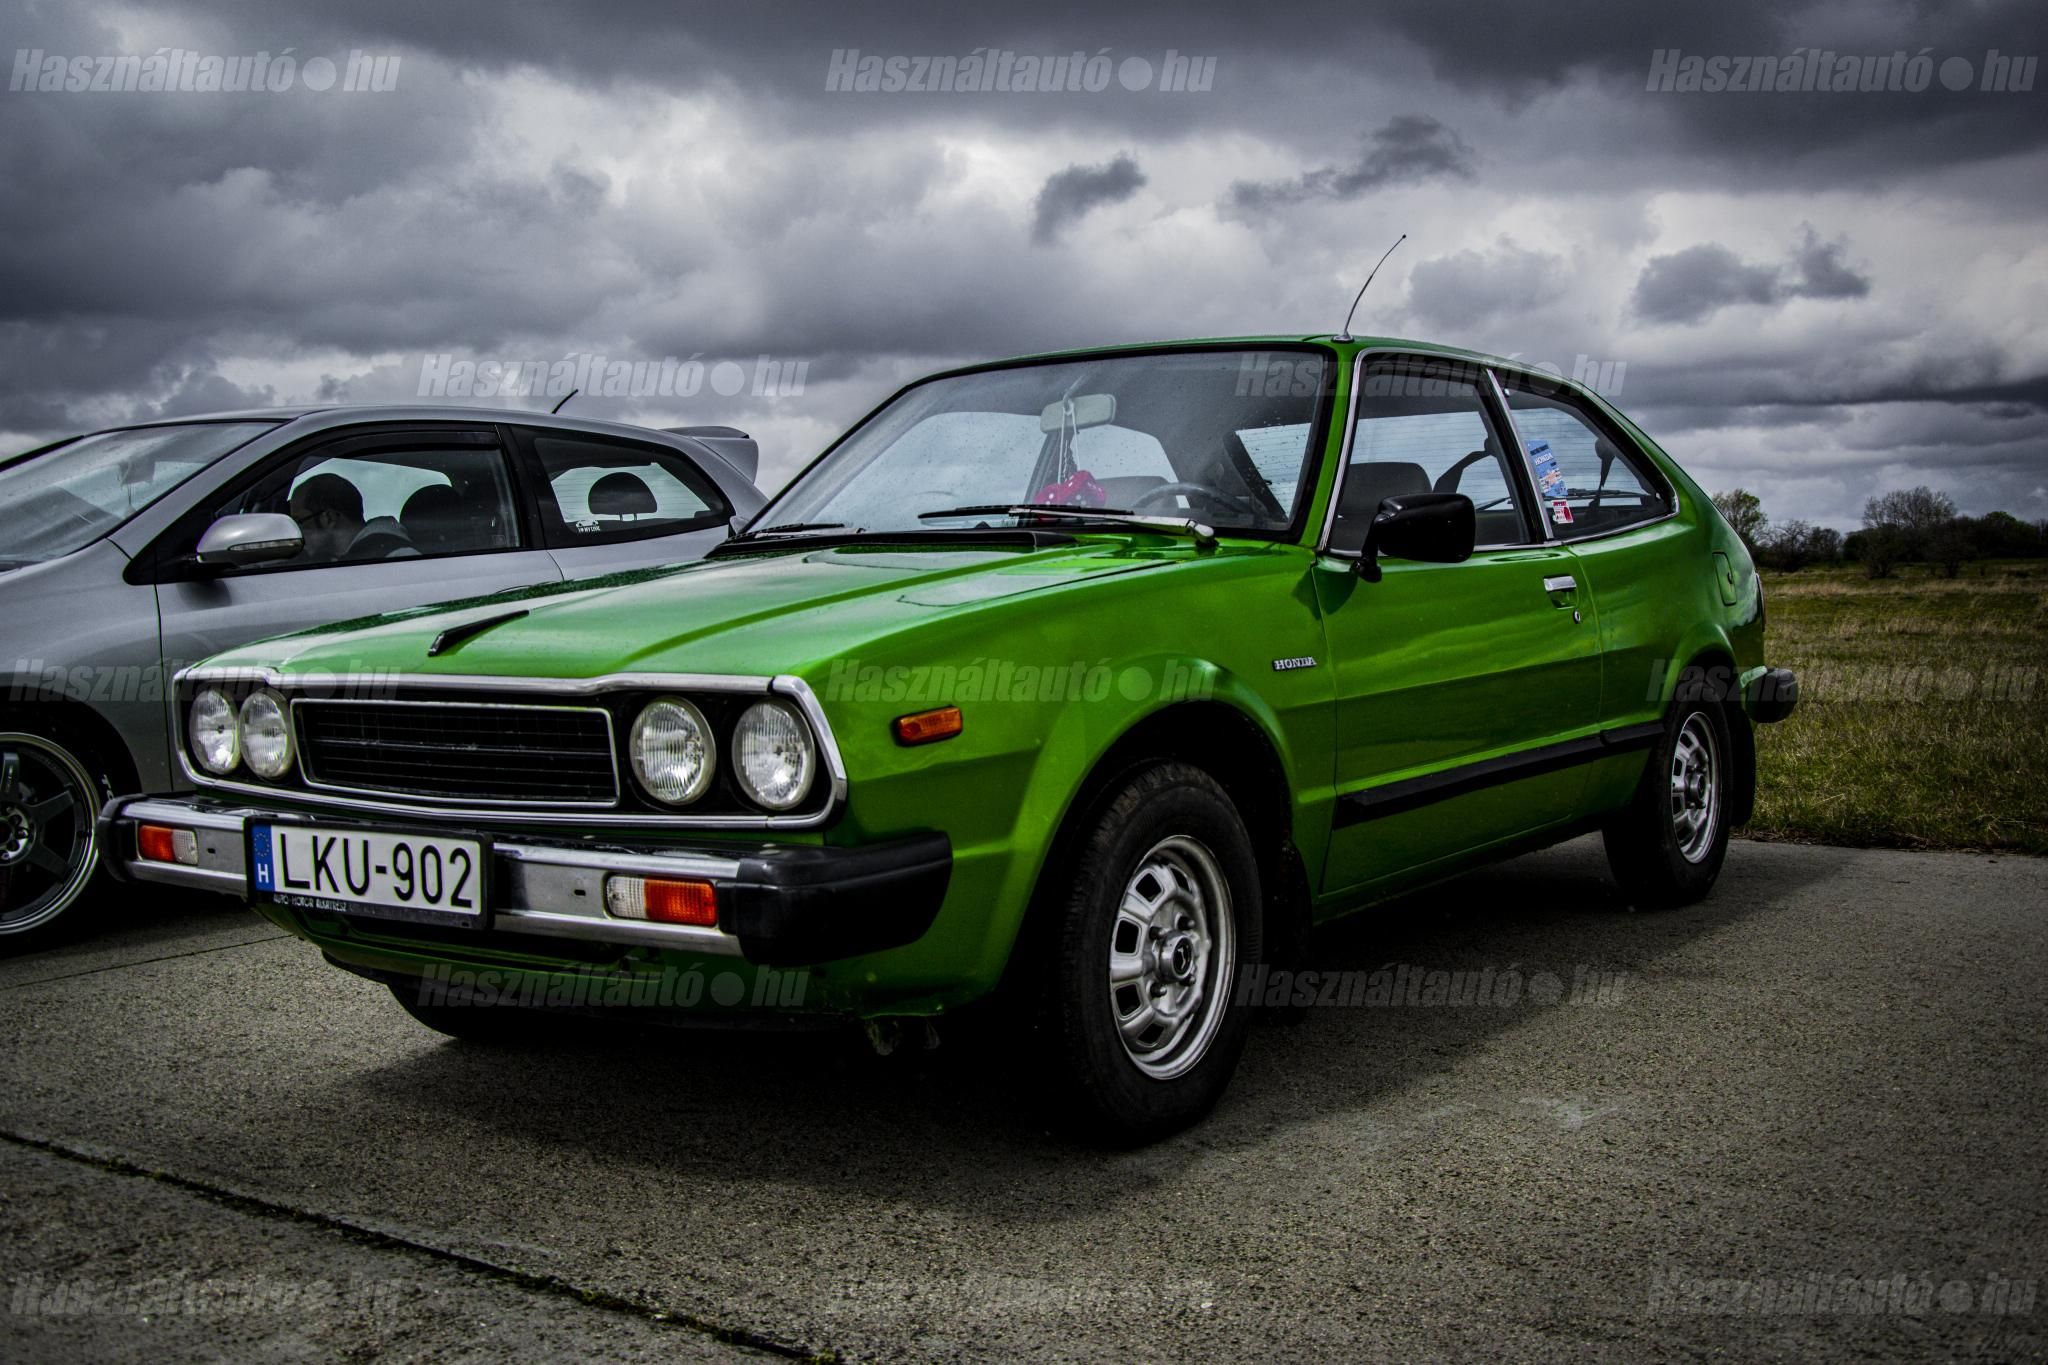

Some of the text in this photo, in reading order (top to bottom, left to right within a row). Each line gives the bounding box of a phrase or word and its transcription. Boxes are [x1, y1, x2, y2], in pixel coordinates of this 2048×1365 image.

[1273, 656, 1317, 671] HONDA
[257, 832, 473, 909] H LKU-902
